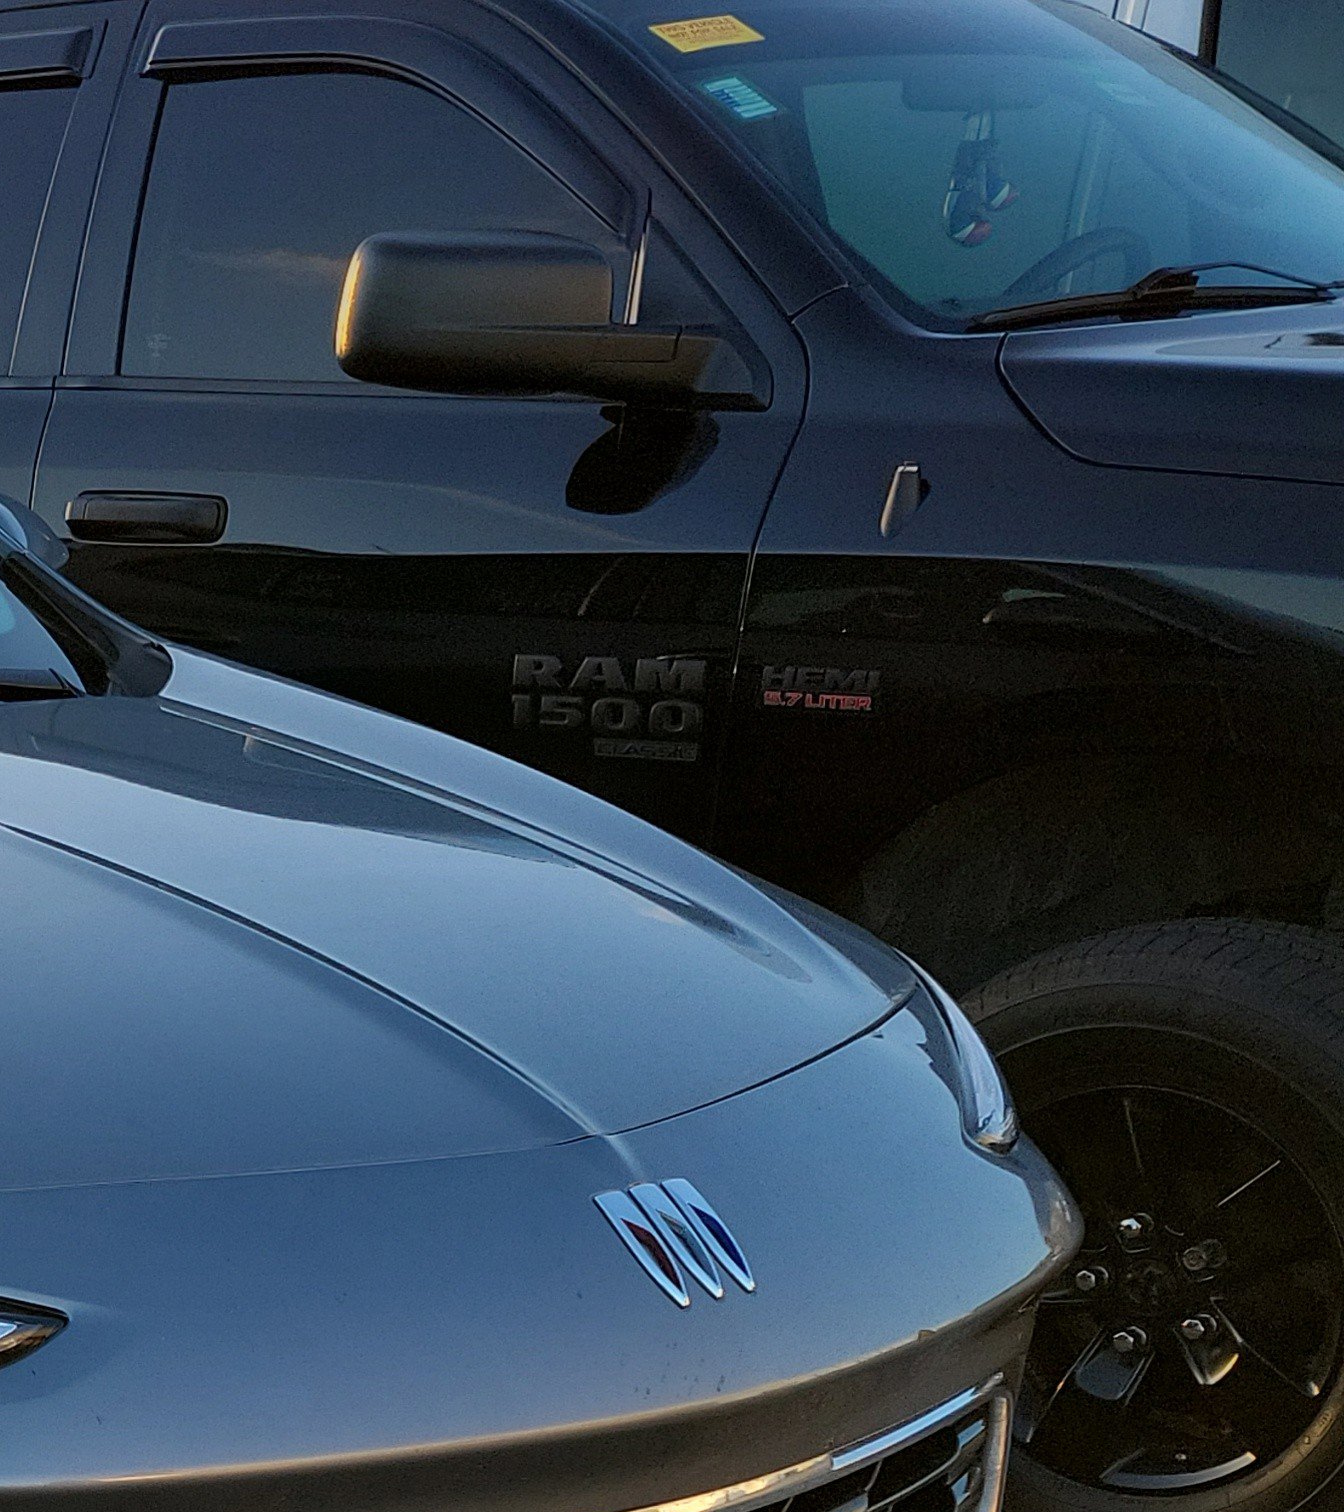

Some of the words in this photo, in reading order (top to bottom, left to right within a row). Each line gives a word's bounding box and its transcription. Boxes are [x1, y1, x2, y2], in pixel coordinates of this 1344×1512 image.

[512, 653, 707, 691] RAM
[761, 665, 881, 690] HEMI
[511, 692, 702, 732] 1500
[803, 693, 872, 711] LITER
